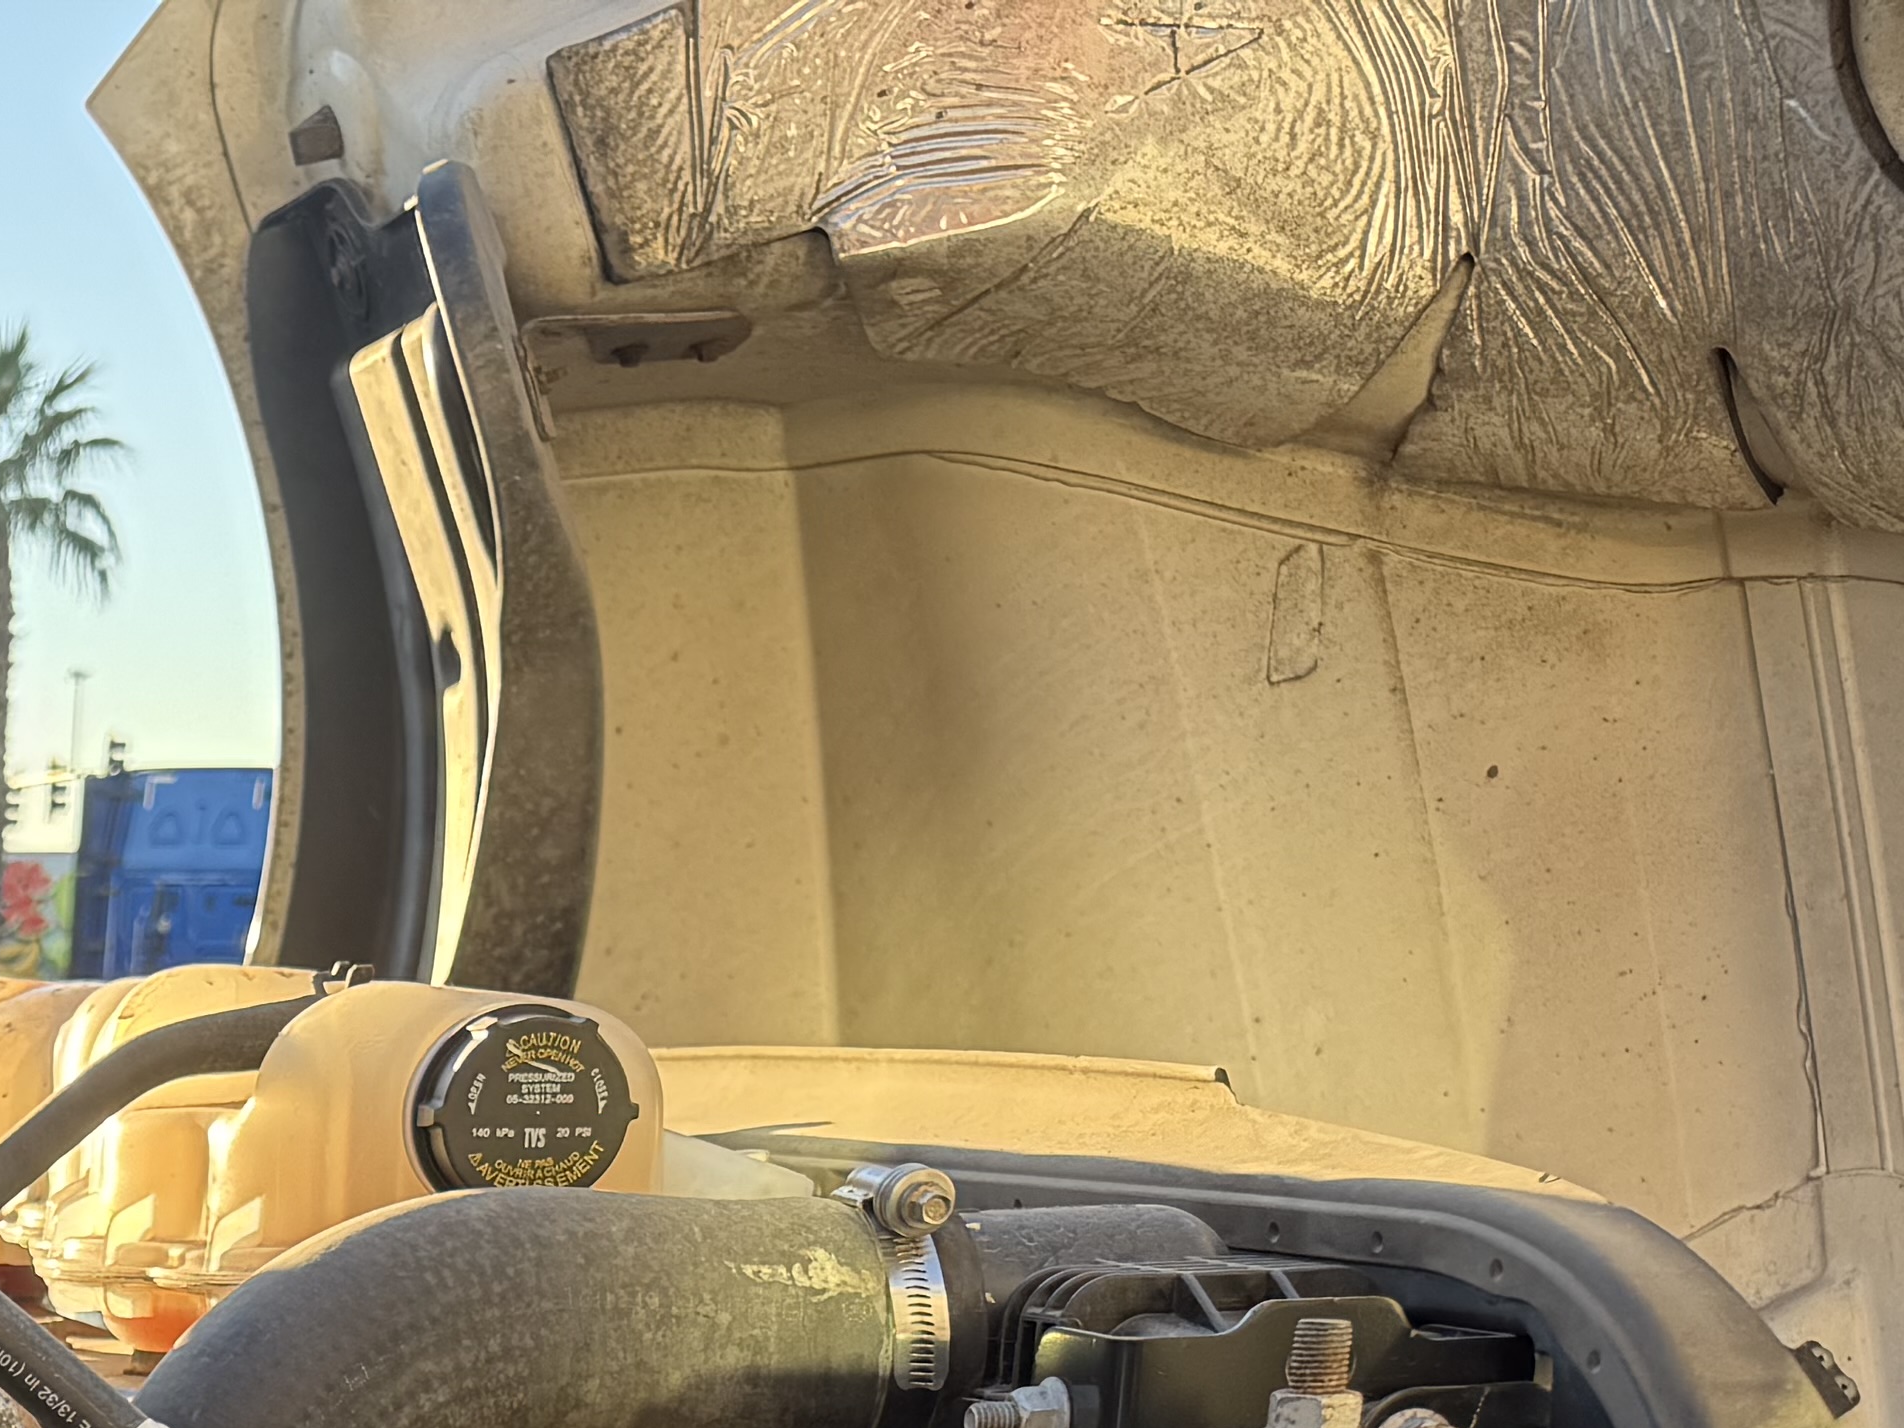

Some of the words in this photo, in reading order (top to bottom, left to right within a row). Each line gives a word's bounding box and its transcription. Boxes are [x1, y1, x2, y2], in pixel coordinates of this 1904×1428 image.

[520, 1032, 582, 1054] CAUTION
[508, 1072, 575, 1083] PRESSURIZED
[521, 1083, 561, 1093] SYSTEM
[524, 1127, 546, 1148] TVS
[556, 1127, 570, 1138] 20
[575, 1127, 592, 1138] PSI
[24, 1372, 41, 1393] in
[37, 1388, 80, 1424] 13/32
